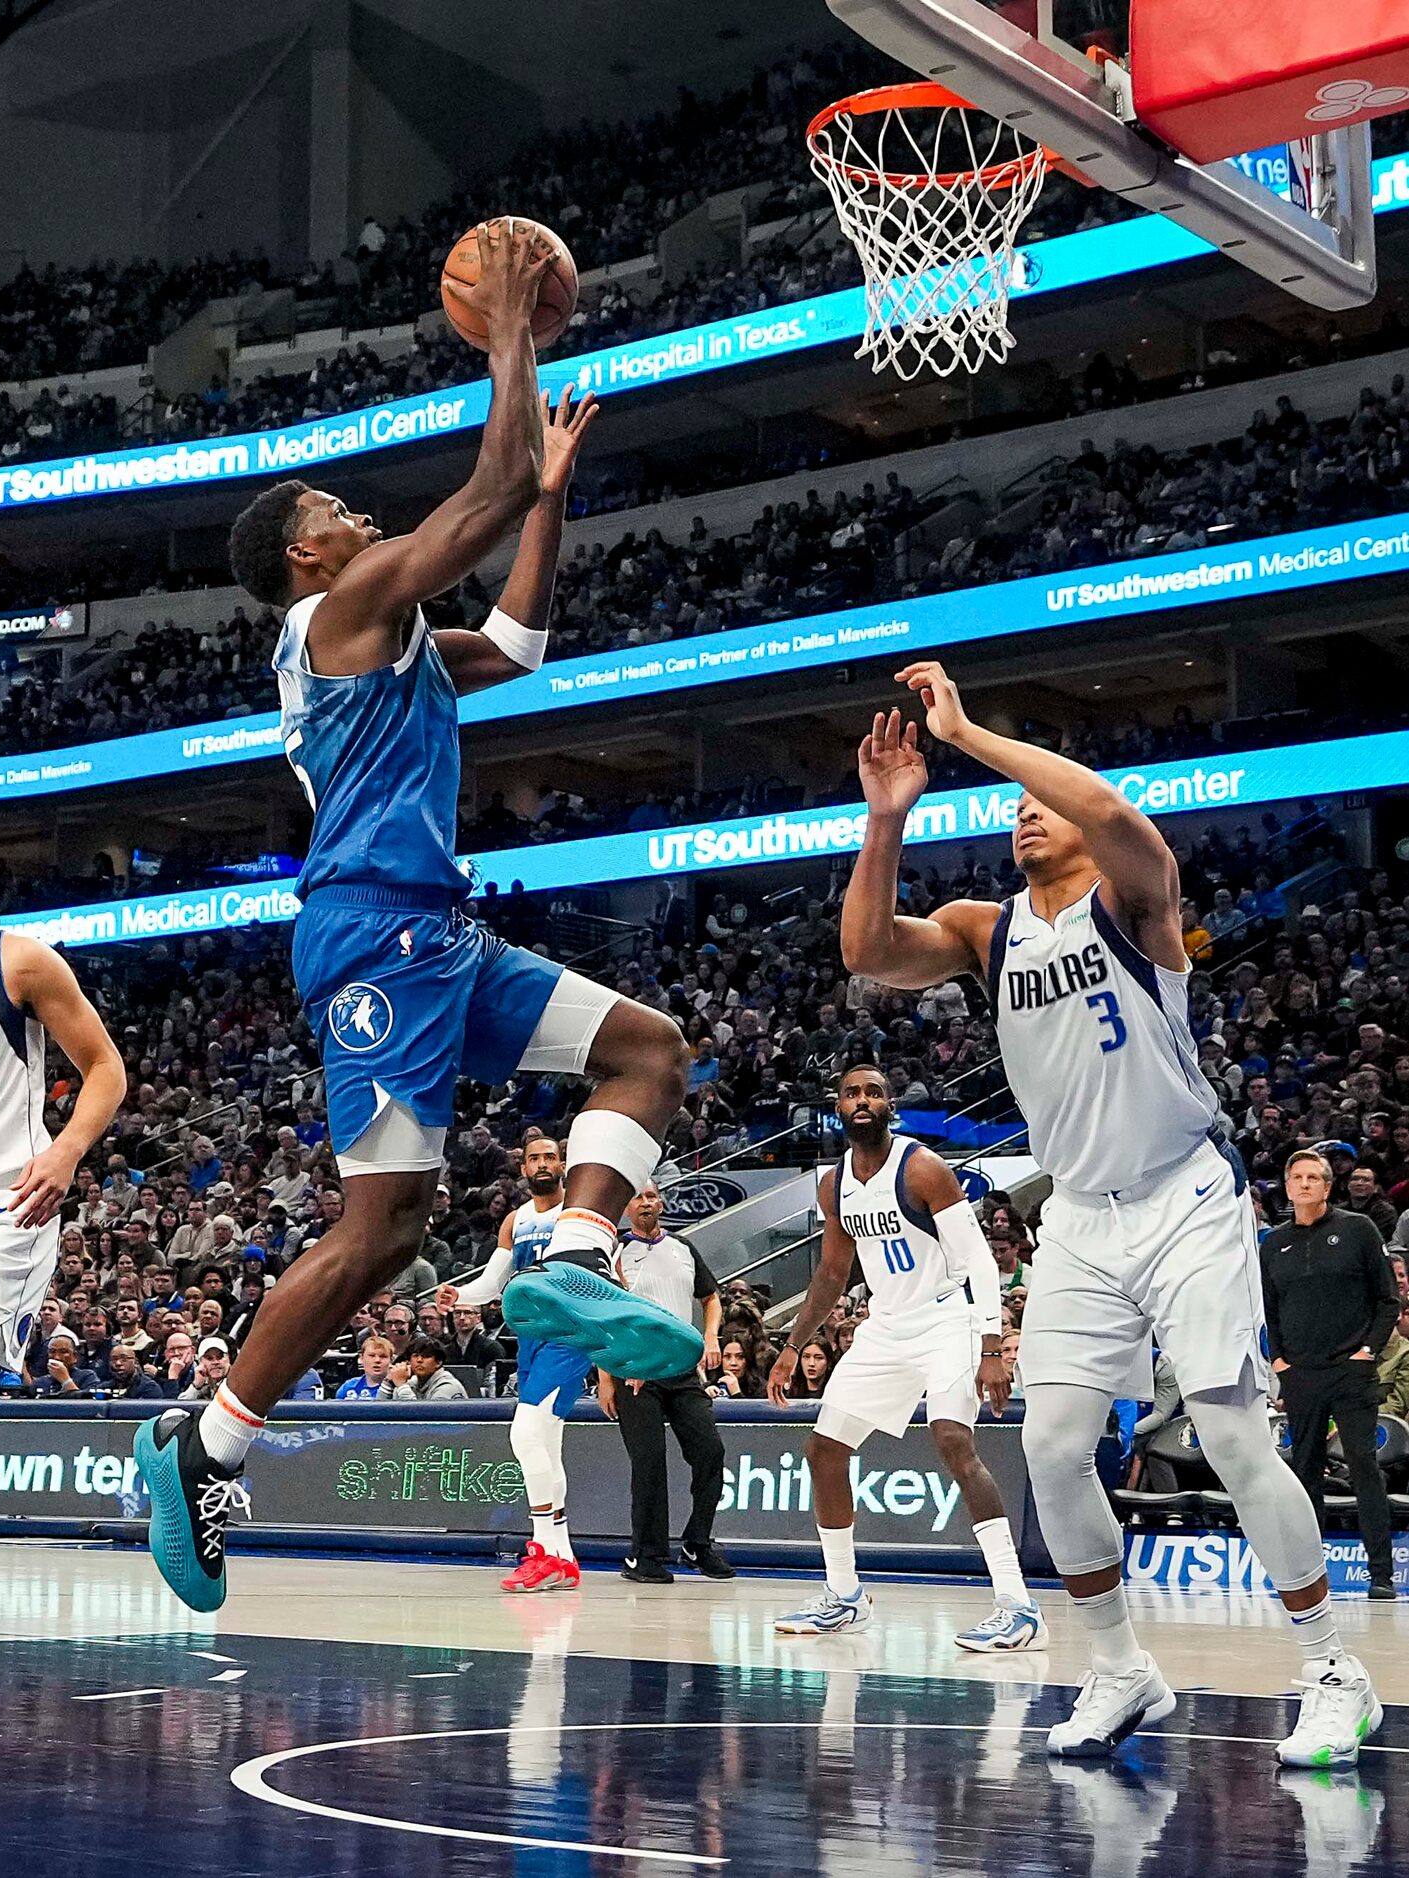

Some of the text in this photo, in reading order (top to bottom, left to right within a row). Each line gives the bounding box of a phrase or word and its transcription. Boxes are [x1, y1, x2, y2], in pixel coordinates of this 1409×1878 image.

[576, 361, 602, 391] #1
[609, 334, 704, 380] Hospital
[709, 333, 731, 359] in
[257, 413, 368, 468] Medical
[370, 396, 465, 440] Center
[1258, 532, 1350, 577] Medical
[549, 619, 910, 693] The Official Health Care Partner of the Dallas Mavericks
[5, 768, 41, 784] Dallas
[41, 760, 92, 780] Mavericks
[1116, 768, 1245, 810] Center
[121, 894, 217, 935] Medical
[1007, 943, 1108, 1012] DALLAS
[1084, 990, 1128, 1056] 3
[842, 1209, 902, 1238] DALLAS
[880, 1237, 916, 1275] 10
